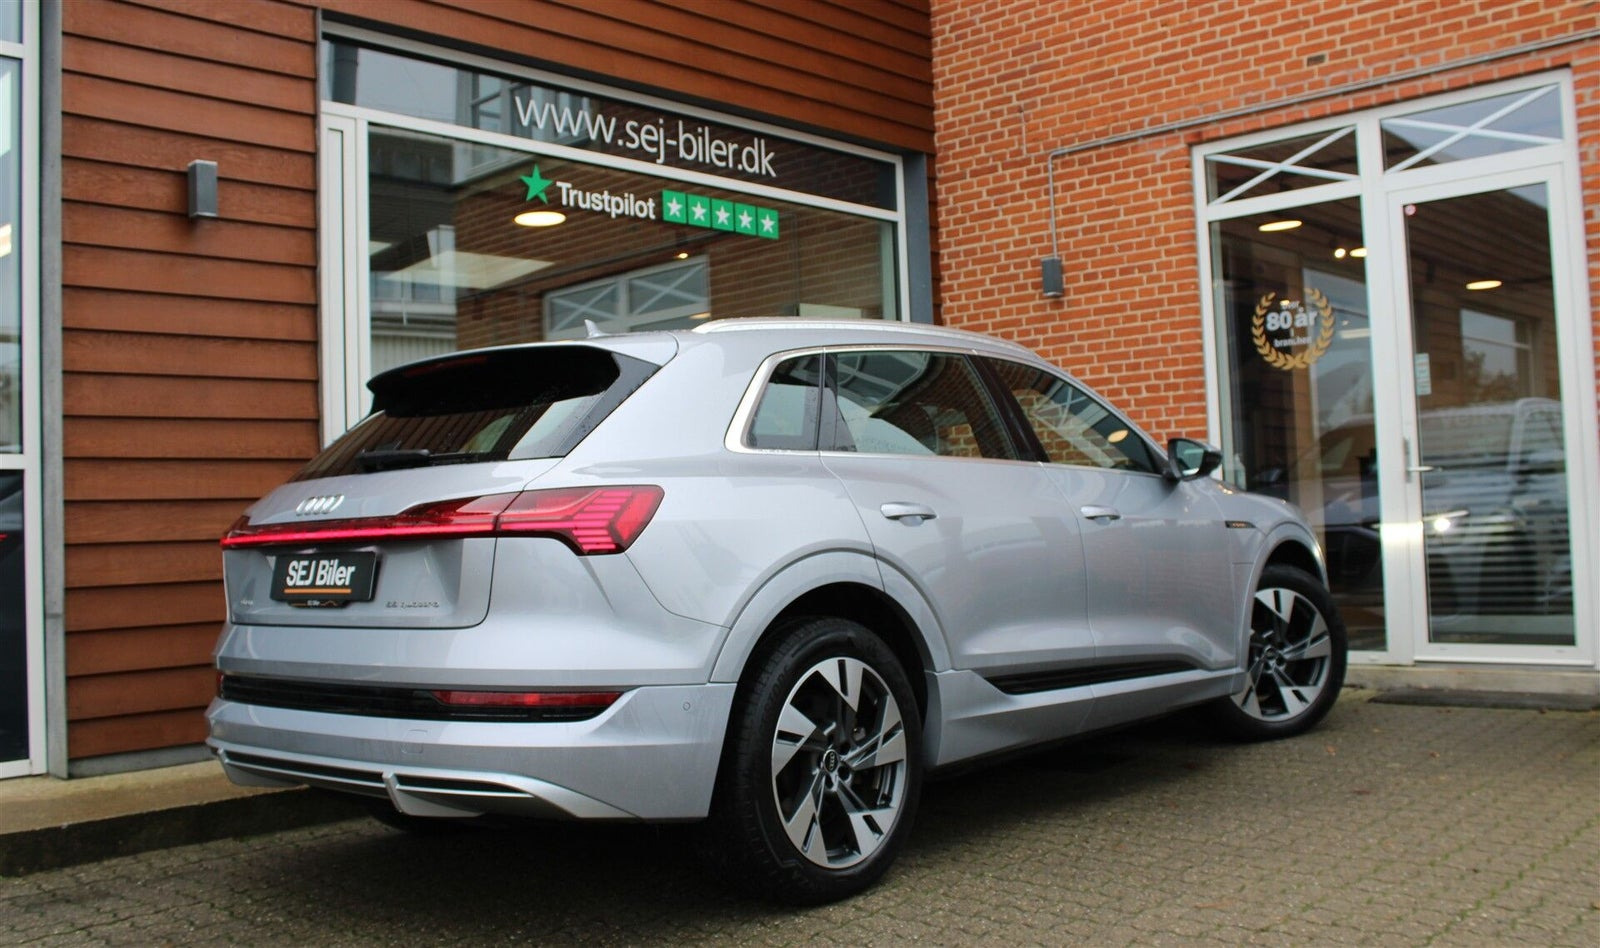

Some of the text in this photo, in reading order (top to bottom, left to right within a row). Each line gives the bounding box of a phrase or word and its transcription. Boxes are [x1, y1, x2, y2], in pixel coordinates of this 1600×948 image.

[514, 96, 777, 177] www.sej-biler.dk
[556, 181, 656, 220] Trustpilot
[1266, 306, 1317, 330] 80 år
[286, 558, 356, 587] SEJ Biler
